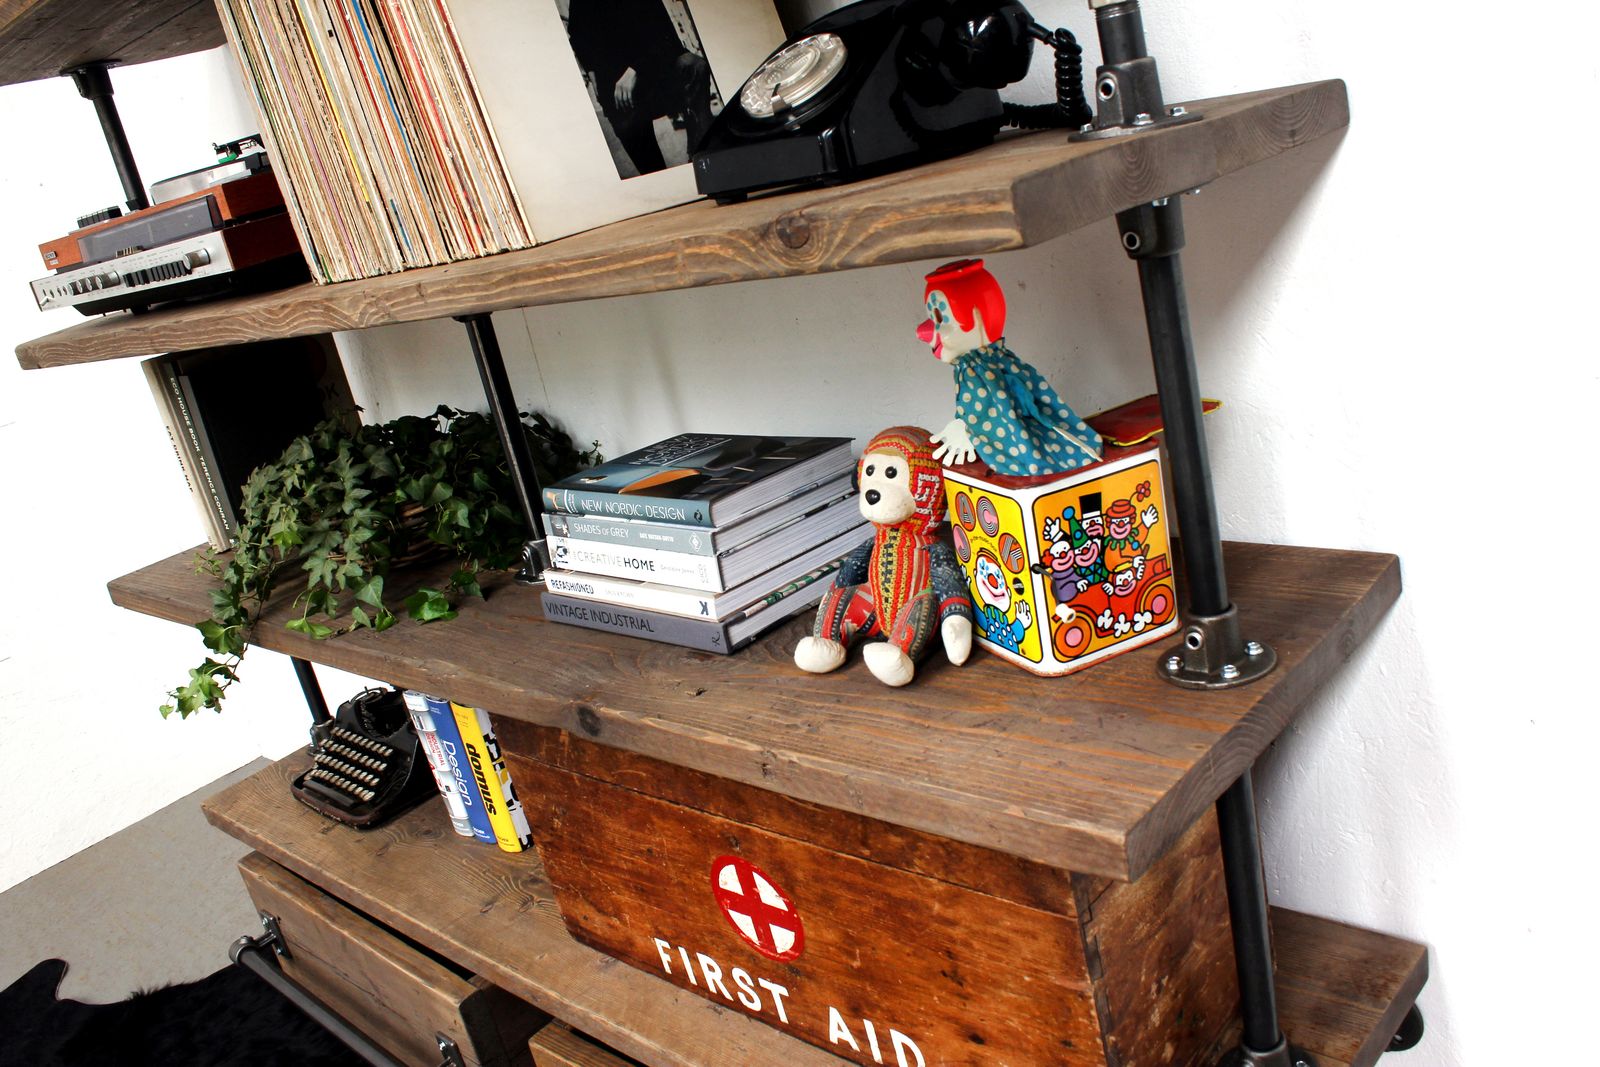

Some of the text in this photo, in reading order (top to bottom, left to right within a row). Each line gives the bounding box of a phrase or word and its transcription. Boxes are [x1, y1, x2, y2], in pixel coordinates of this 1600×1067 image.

[170, 377, 230, 530] ECO HOUSE BOOK TERENCE CONRAN
[581, 499, 603, 513] NEW
[605, 502, 642, 517] NORDIC
[645, 504, 686, 521] DESIGN
[574, 522, 601, 535] SHADES
[610, 526, 629, 538] GREY
[577, 550, 622, 567] CREATIVE
[624, 557, 656, 572] HOME
[551, 578, 595, 595] REFASHIONED
[544, 600, 655, 633] VINTAGE INDUSTRIAL
[430, 731, 446, 767] INDUSTRIAL
[443, 739, 473, 807] Design
[465, 742, 497, 816] domus
[654, 937, 927, 1067] FIRST AID
